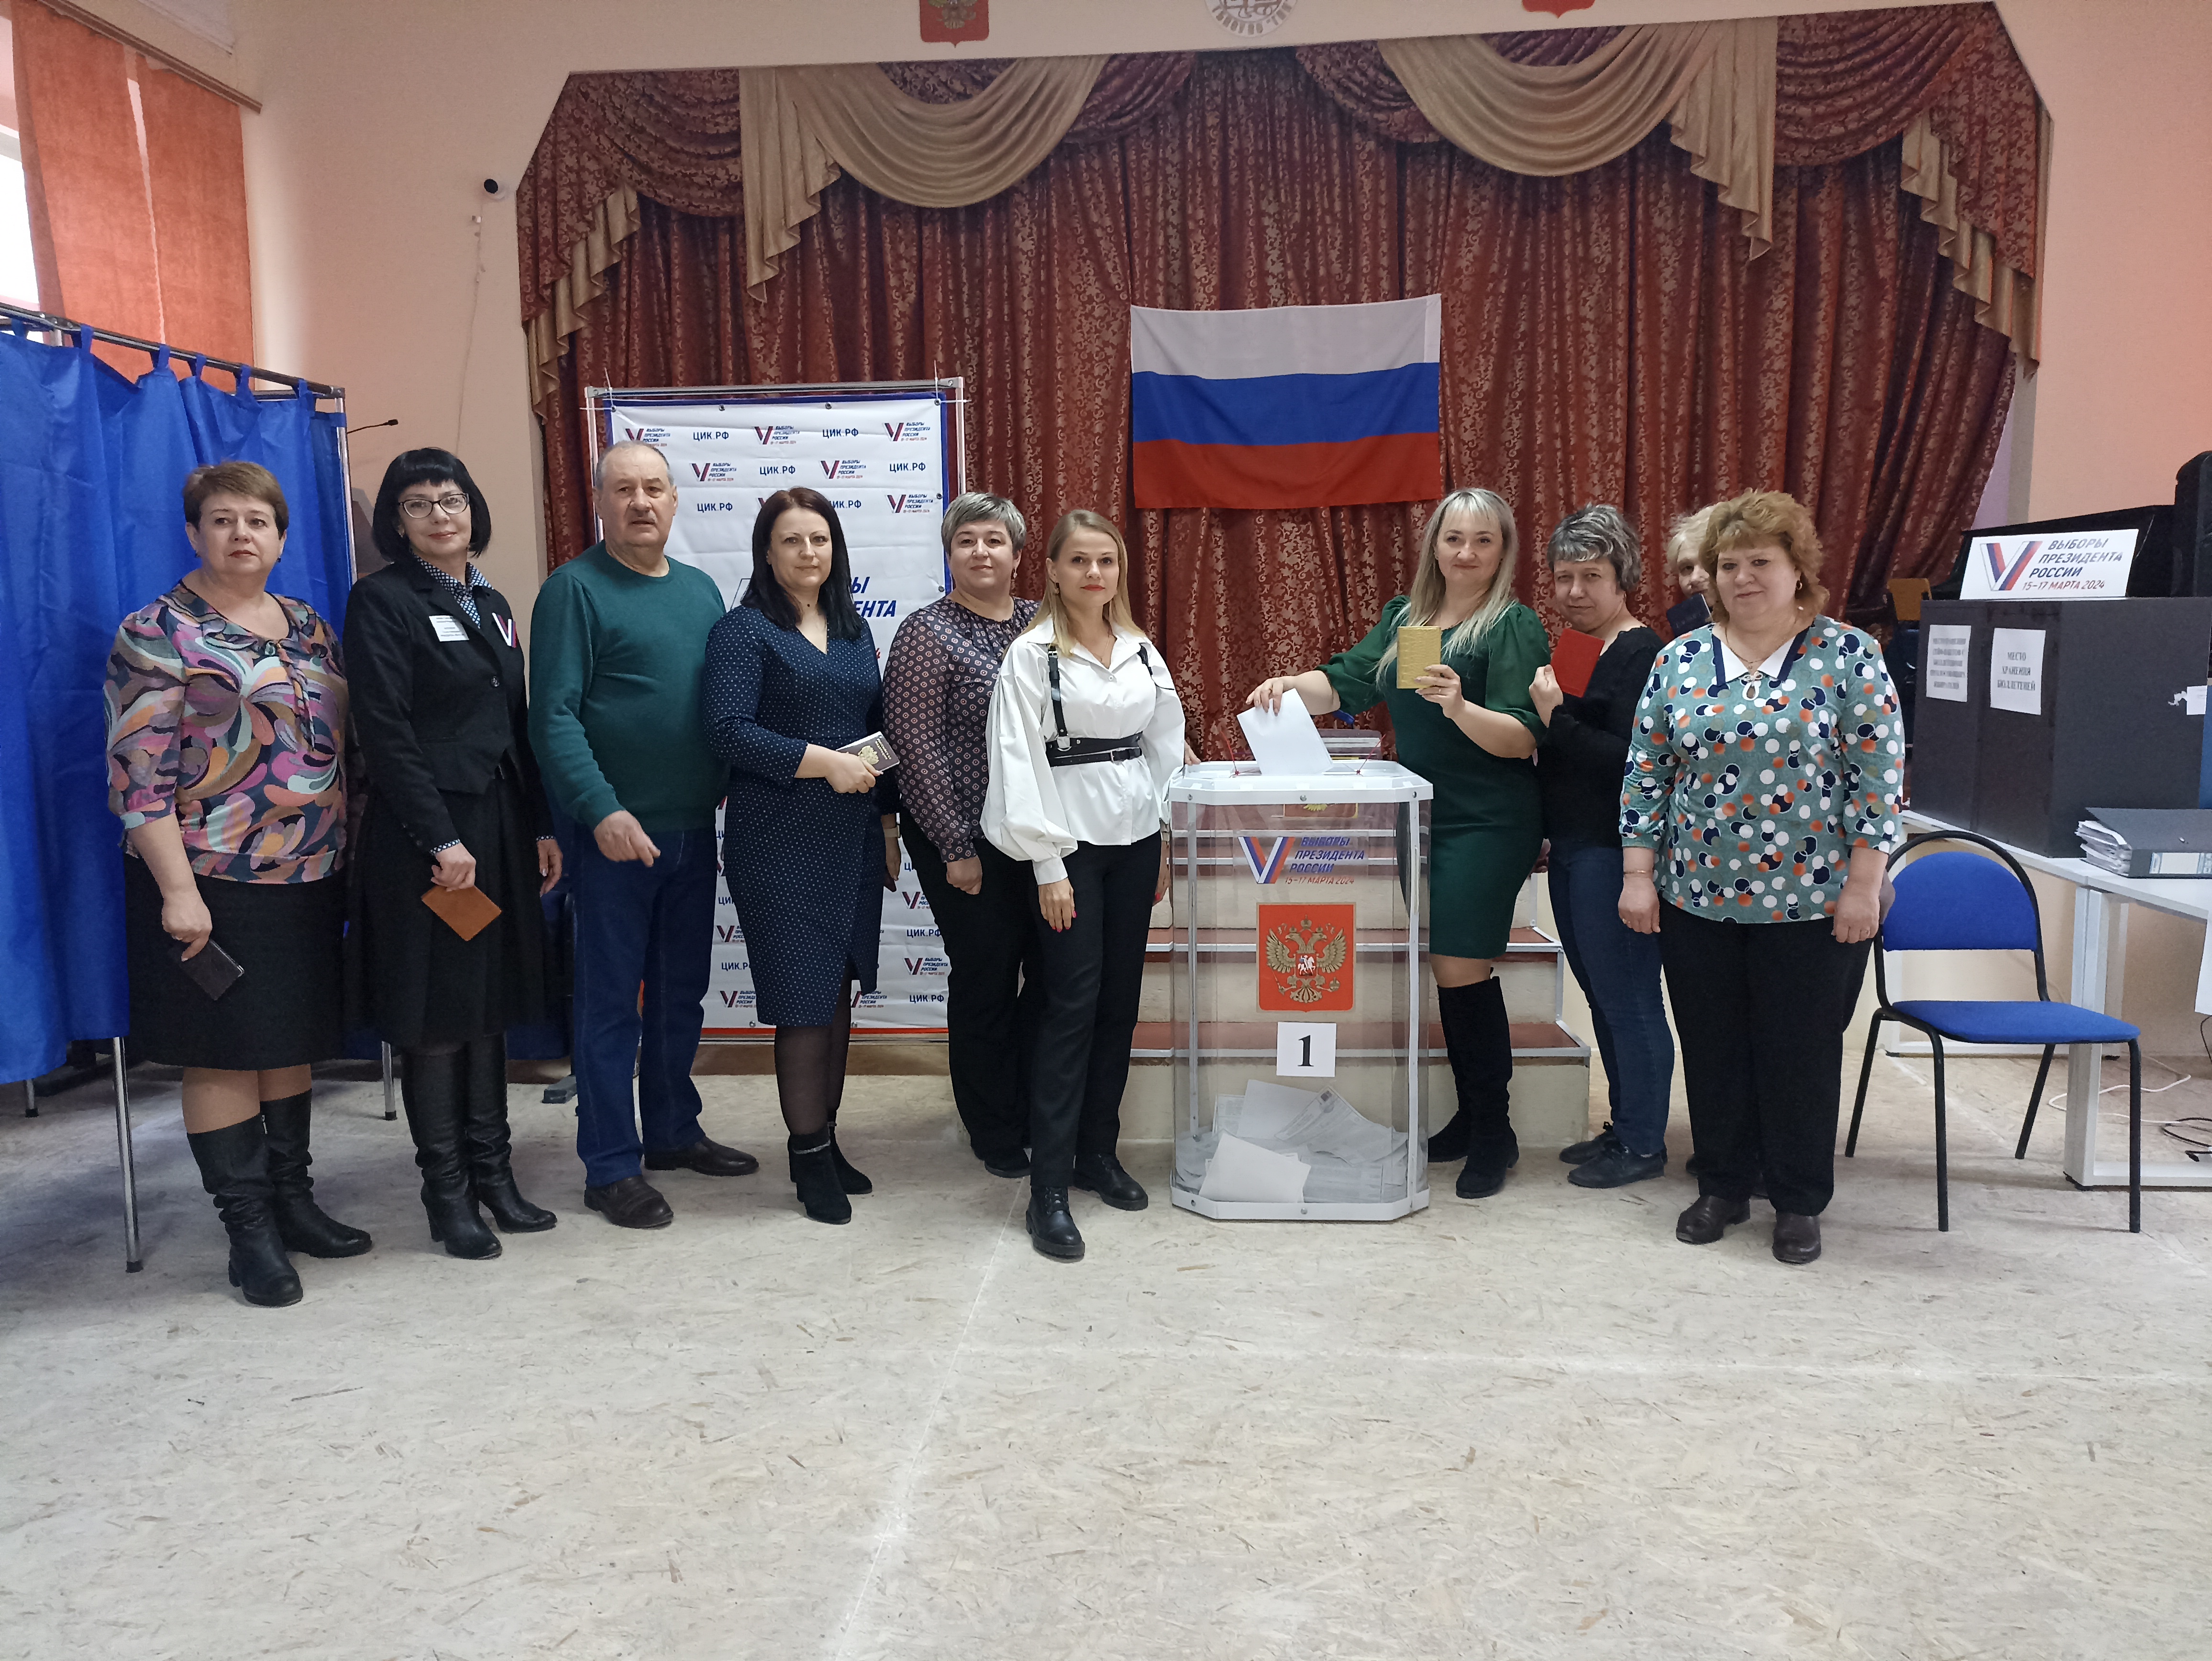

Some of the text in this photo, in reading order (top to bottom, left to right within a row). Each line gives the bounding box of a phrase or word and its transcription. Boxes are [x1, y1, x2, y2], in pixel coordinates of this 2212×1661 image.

[693, 431, 729, 441] ЦИК.РФ
[822, 428, 859, 439] ЦИК.РФ
[760, 465, 796, 476] ЦИК.РФ
[889, 462, 926, 473] ЦИК.РФ
[697, 502, 733, 513] ЦИК.РФ
[832, 500, 862, 509] ИК.РФ
[2048, 538, 2110, 550] ВЫБОРЫ
[2038, 551, 2124, 564] ПРЕЗИДЕНТА
[2029, 567, 2083, 578] РОССИИ
[2048, 581, 2080, 590] МАРТА
[2081, 580, 2105, 589] 2024
[2008, 652, 2026, 661] МЕСТО
[1300, 836, 1350, 846] ВЫБОРЫ
[1294, 850, 1364, 861] ПРЕЗИДЕНТА
[1289, 863, 1335, 873] РОССИИ
[1308, 876, 1334, 885] МАРТА
[721, 962, 749, 971] ЦИК.Р
[909, 995, 944, 1004] ЦИК.РФ
[1297, 1035, 1314, 1067] 1
